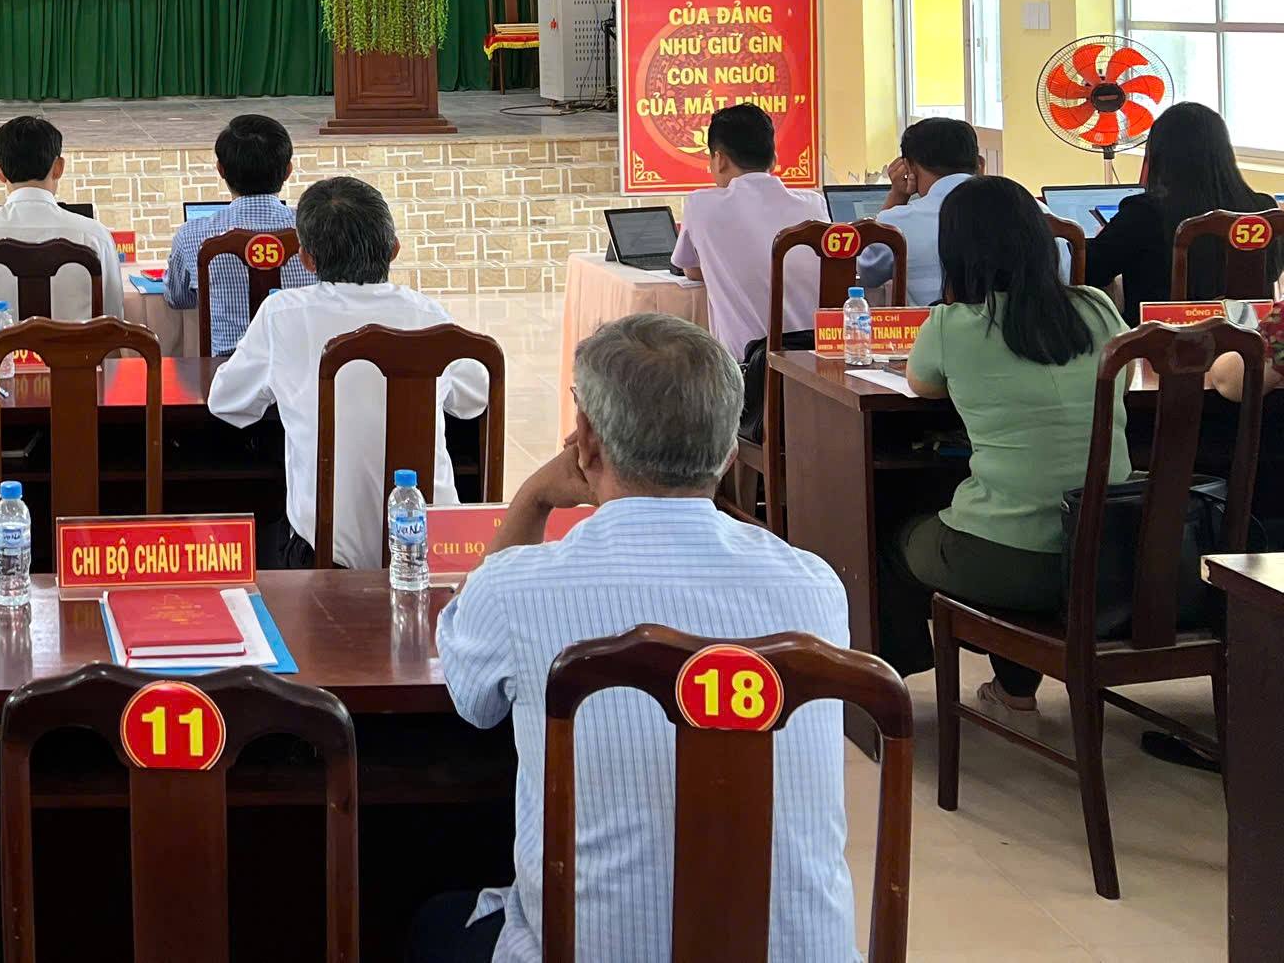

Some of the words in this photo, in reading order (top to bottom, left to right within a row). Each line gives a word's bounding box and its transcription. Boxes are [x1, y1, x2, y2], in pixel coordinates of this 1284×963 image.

[669, 1, 710, 25] CỦA
[717, 0, 773, 24] ĐẢNG
[659, 35, 703, 56] NHƯ
[707, 32, 743, 55] GIỮ
[749, 31, 782, 53] GÌN
[667, 67, 708, 85] CON
[636, 92, 677, 116] CỦA
[684, 91, 727, 115] MẮT
[827, 231, 856, 252] 67
[1236, 222, 1266, 245] 52
[251, 242, 280, 263] 35
[72, 546, 100, 576] CHI
[106, 537, 129, 580] BỘ
[134, 536, 180, 574] CHÂU
[185, 535, 242, 573] THÀNH
[432, 542, 460, 555] CHI
[693, 667, 765, 718] 18
[141, 705, 204, 756] 11
